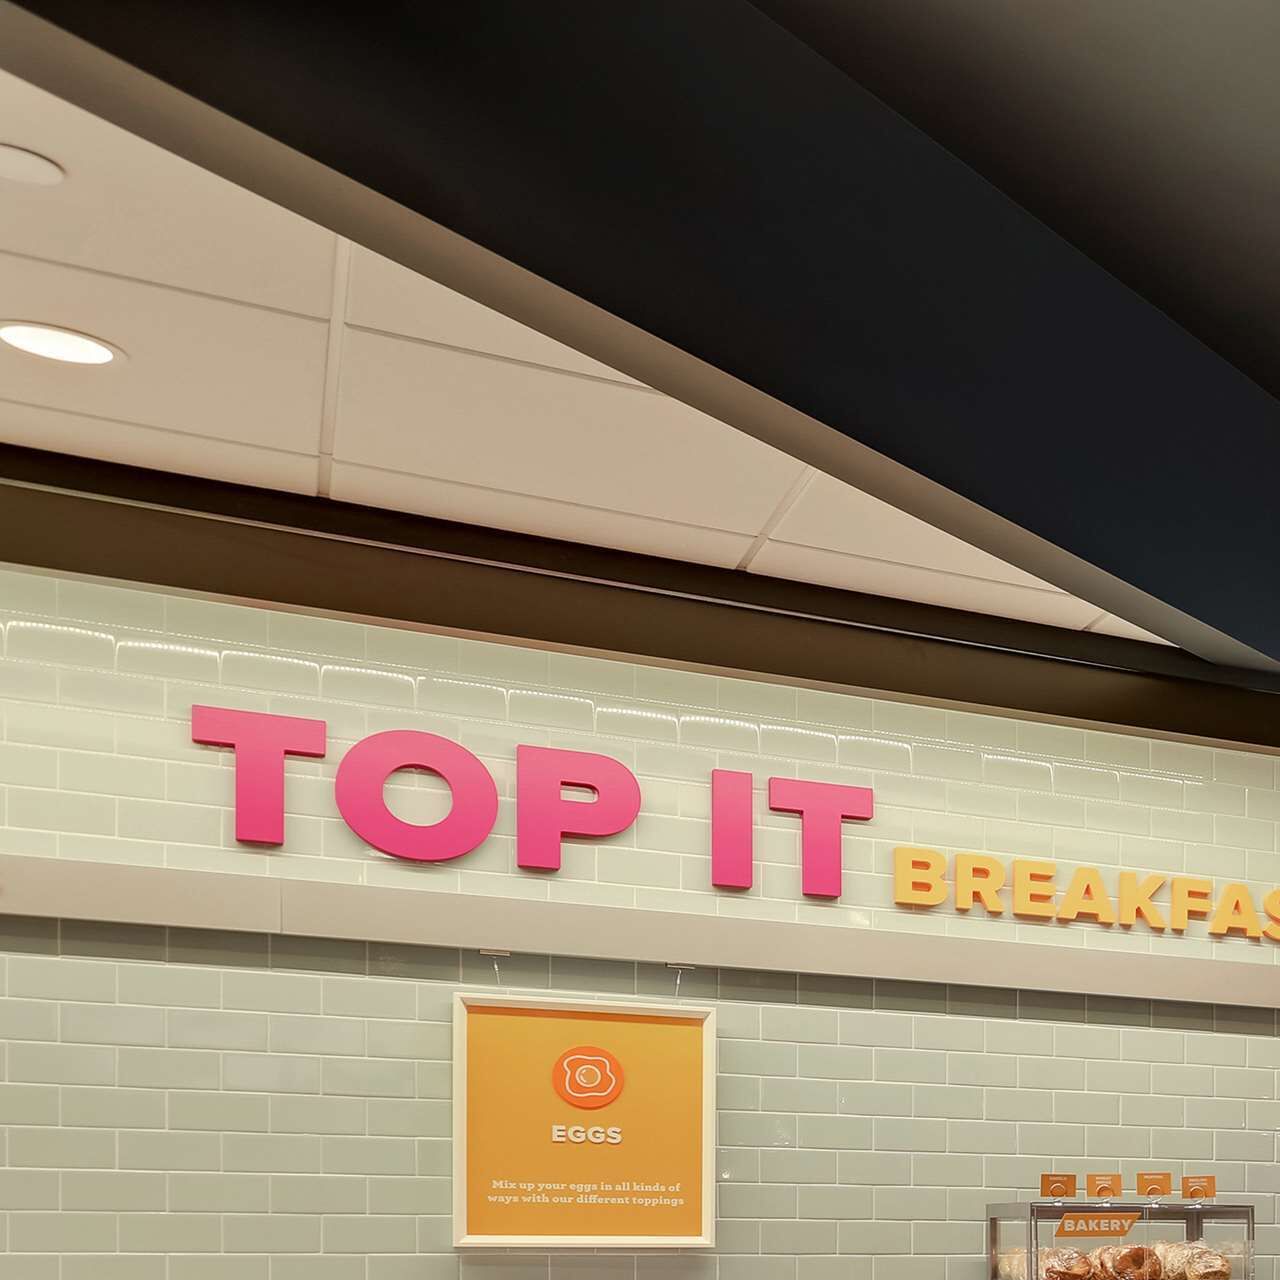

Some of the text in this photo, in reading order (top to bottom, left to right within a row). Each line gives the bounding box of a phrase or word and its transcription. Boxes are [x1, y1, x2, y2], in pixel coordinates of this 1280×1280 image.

[191, 704, 642, 871] TOP
[711, 767, 874, 899] IT
[551, 1125, 623, 1144] EGGS
[491, 1180, 681, 1192] Mix up your eggs in all kinds of
[487, 1193, 684, 1206] ways with our different toppings
[1064, 1219, 1132, 1232] BAKERY
